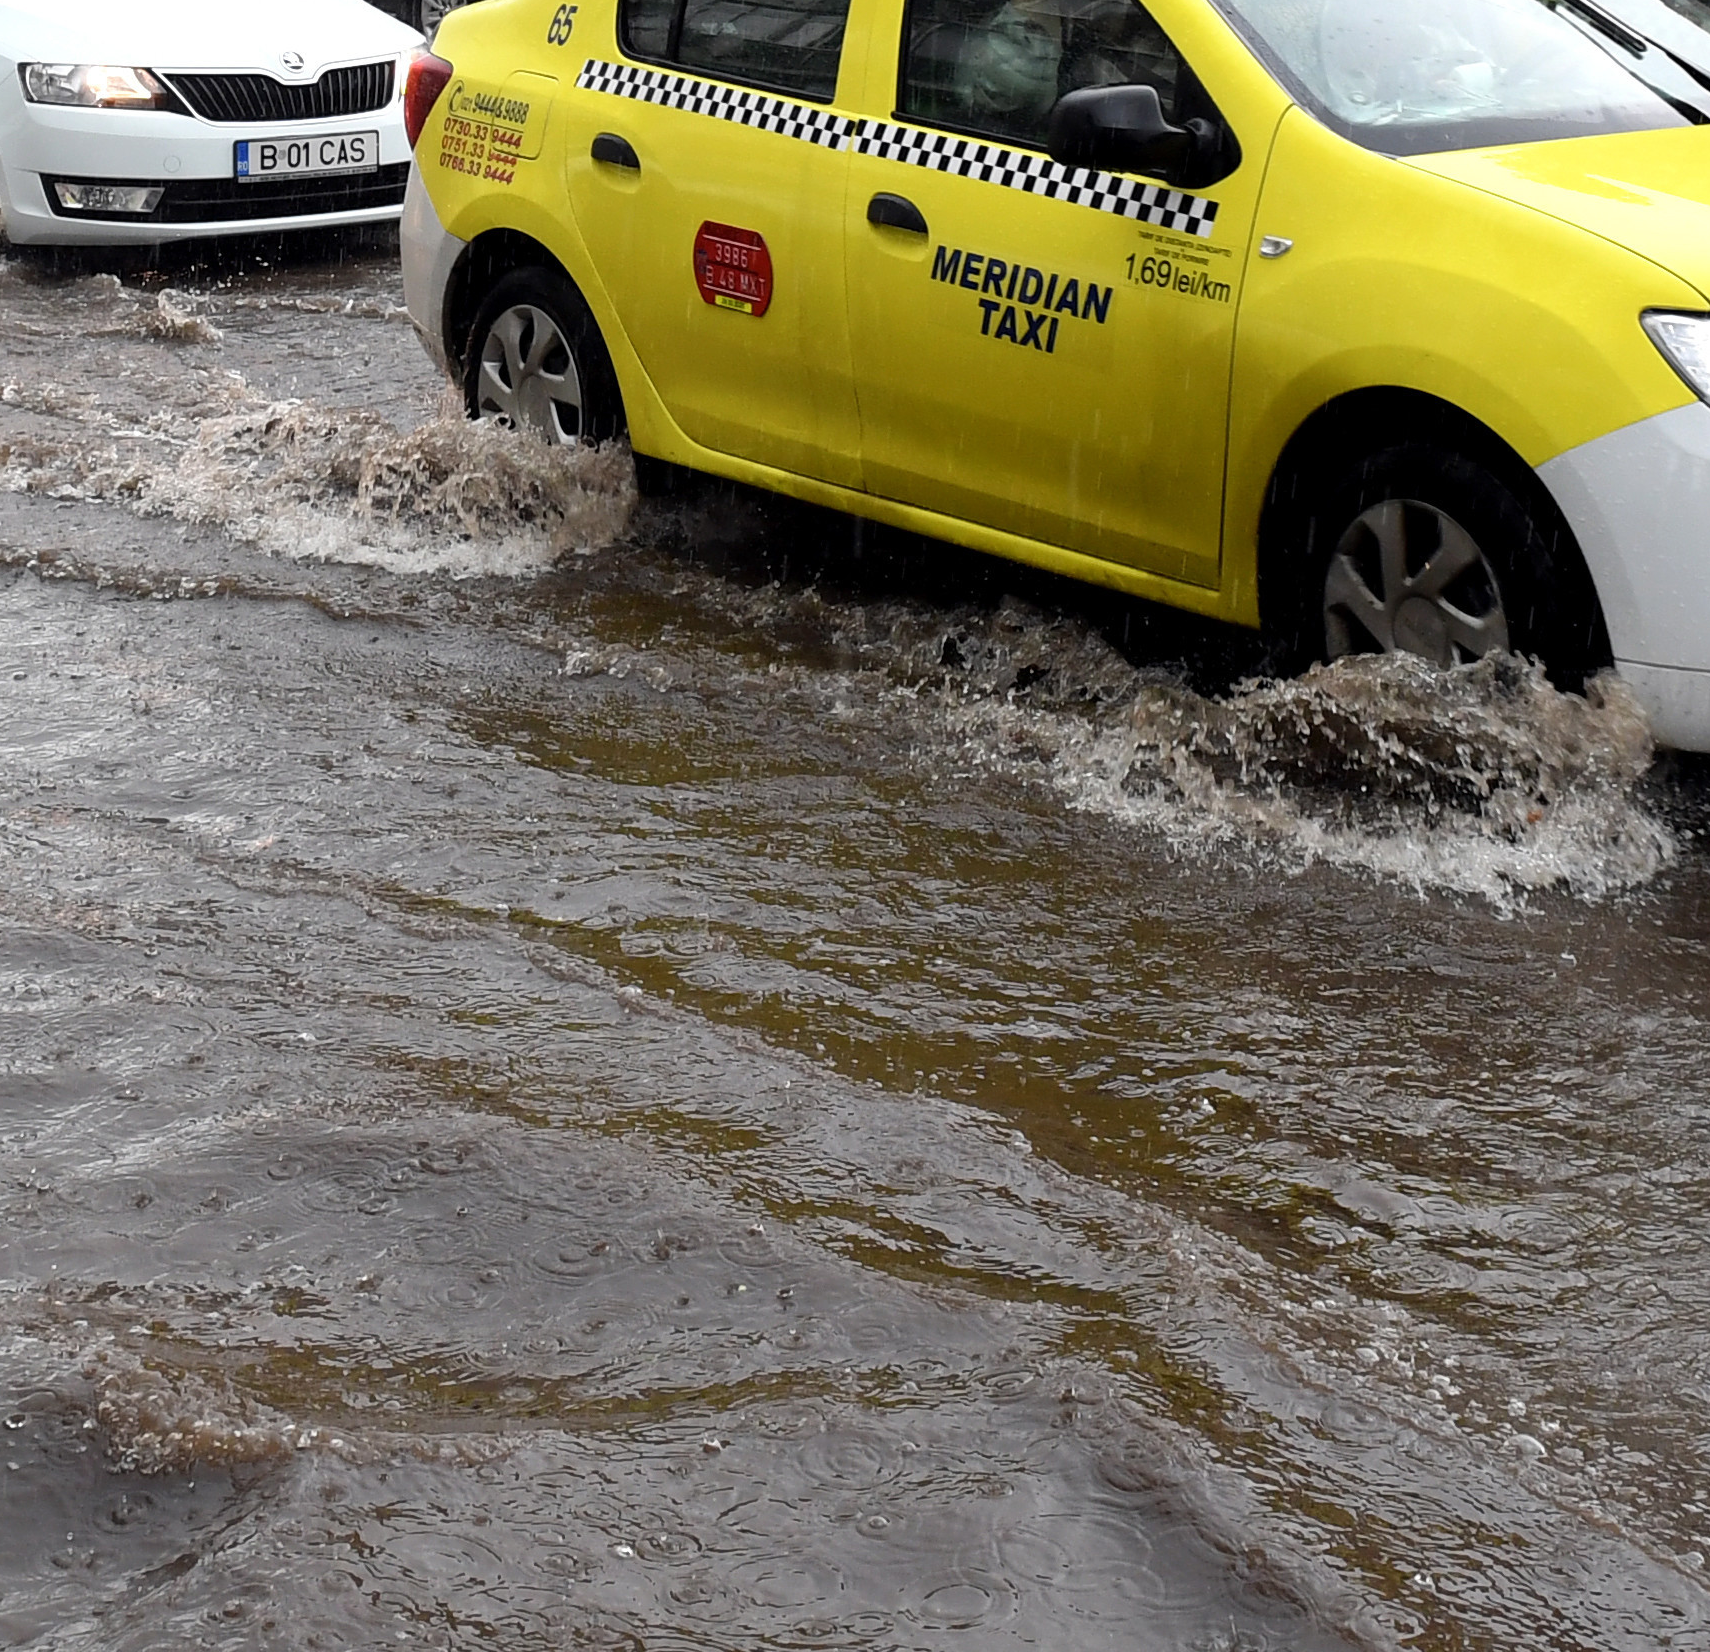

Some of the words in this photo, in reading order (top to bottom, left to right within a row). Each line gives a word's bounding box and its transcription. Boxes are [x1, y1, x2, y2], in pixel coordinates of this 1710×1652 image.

[547, 3, 579, 46] 65
[441, 134, 485, 159] 0751.33
[443, 116, 489, 142] 0730.33
[491, 128, 523, 150] 9444
[260, 144, 278, 171] B
[287, 141, 310, 168] 01
[319, 137, 366, 166] CAS
[439, 151, 482, 177] 0766.33
[482, 164, 516, 186] 9444
[714, 243, 748, 268] 3986
[705, 264, 714, 284] B
[719, 269, 735, 289] 48
[740, 273, 766, 297] MXT
[930, 244, 1114, 325] MERIDIAN
[978, 297, 1059, 355] TAXI
